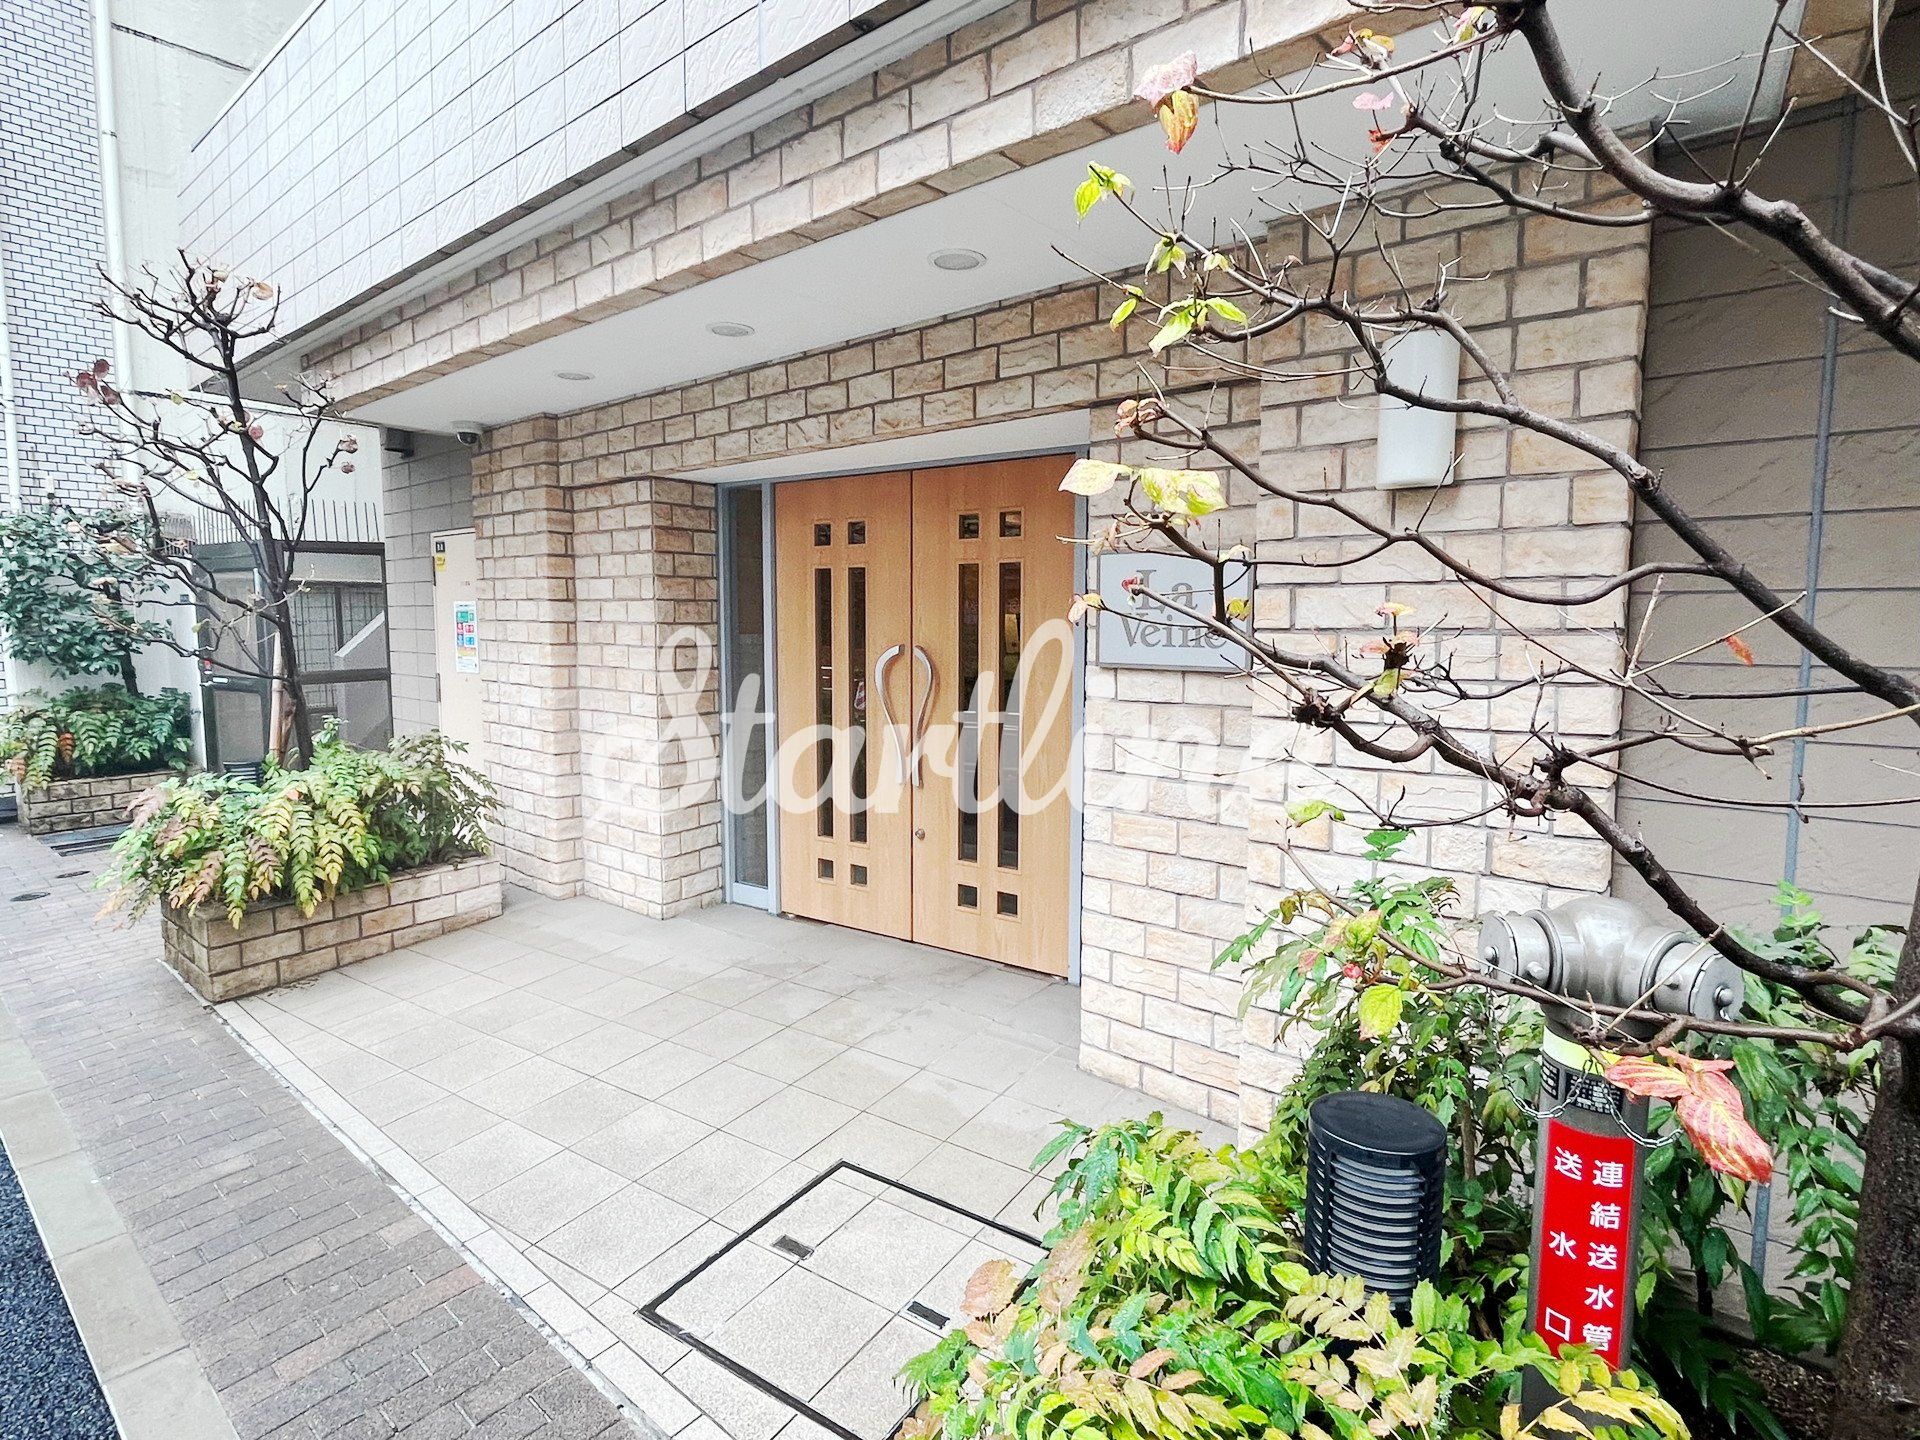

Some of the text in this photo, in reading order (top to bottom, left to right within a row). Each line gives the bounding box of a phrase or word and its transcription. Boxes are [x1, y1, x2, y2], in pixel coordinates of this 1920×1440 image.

[1136, 569, 1198, 613] La
[1544, 1145, 1583, 1342] 送水口
[1582, 1160, 1624, 1352] 連結送水管
